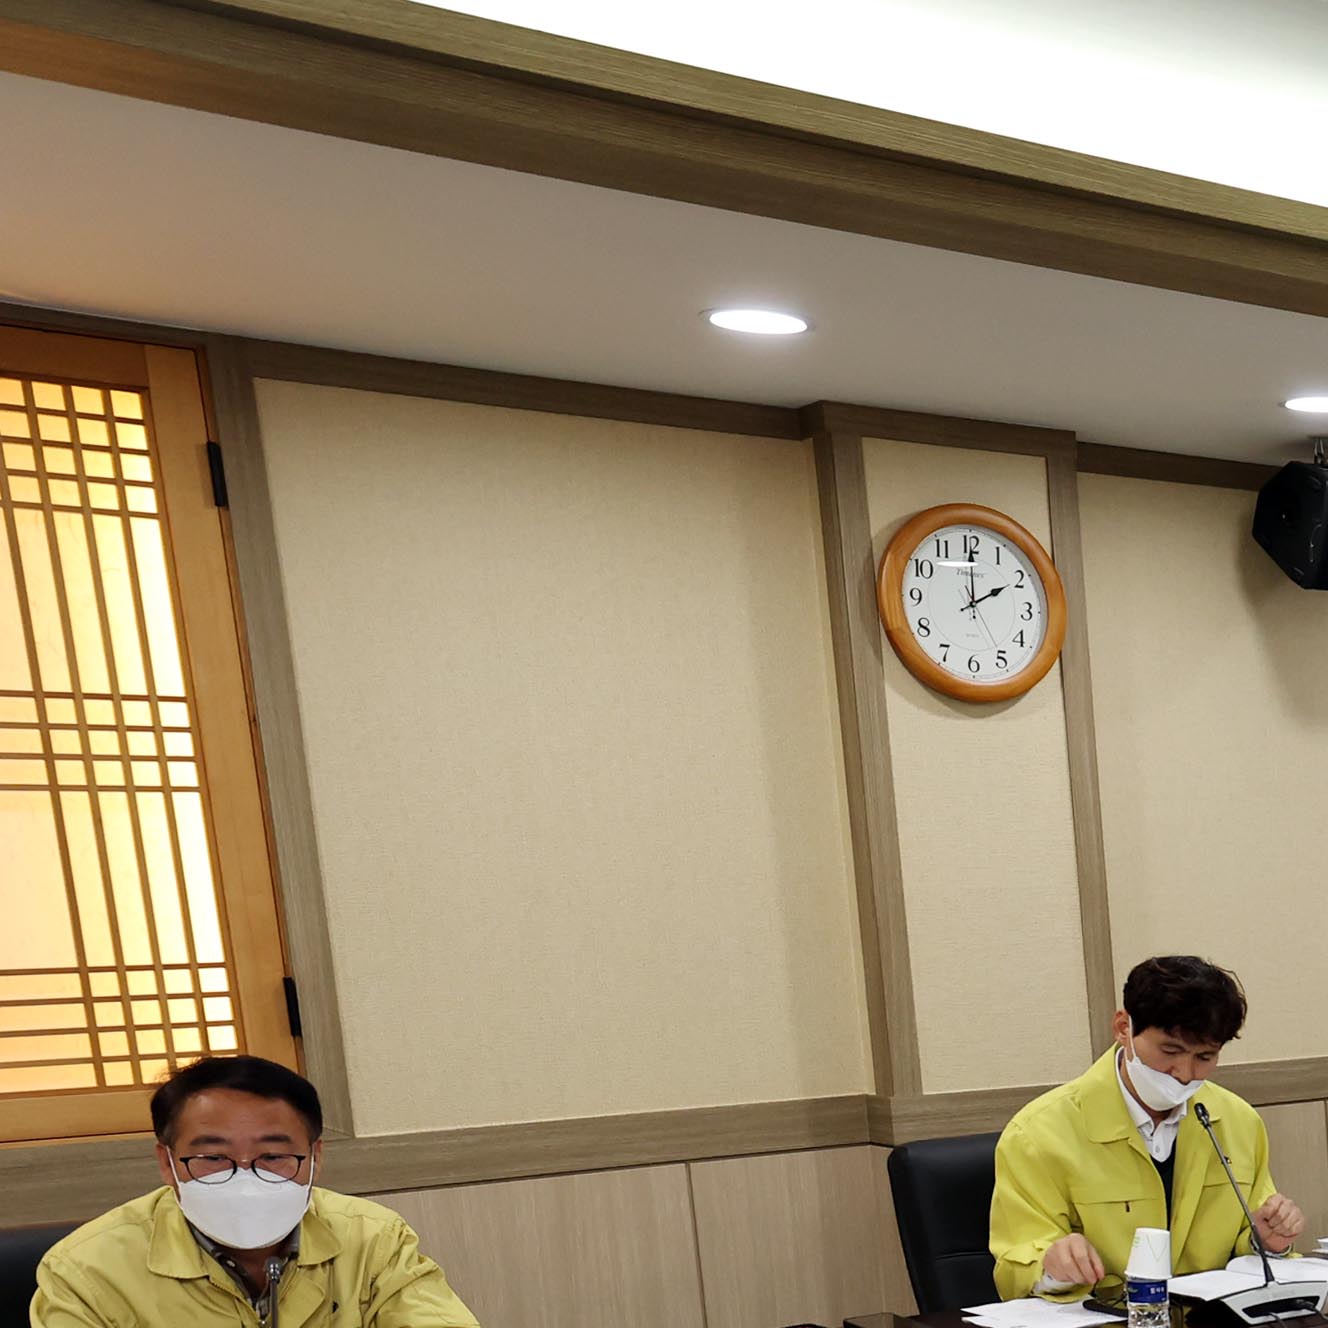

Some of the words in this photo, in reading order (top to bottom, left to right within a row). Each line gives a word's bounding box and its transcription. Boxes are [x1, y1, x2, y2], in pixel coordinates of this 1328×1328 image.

[935, 538, 950, 559] 11
[962, 534, 981, 555] 12
[994, 546, 1001, 566] 1
[914, 558, 935, 579] 10
[1014, 569, 1025, 589] 2
[909, 587, 923, 606] 9
[1020, 601, 1033, 621] 3
[916, 617, 931, 638] 8
[1012, 629, 1026, 648] 4
[938, 643, 950, 663] 7
[995, 650, 1008, 669] 5
[967, 655, 980, 673] 6
